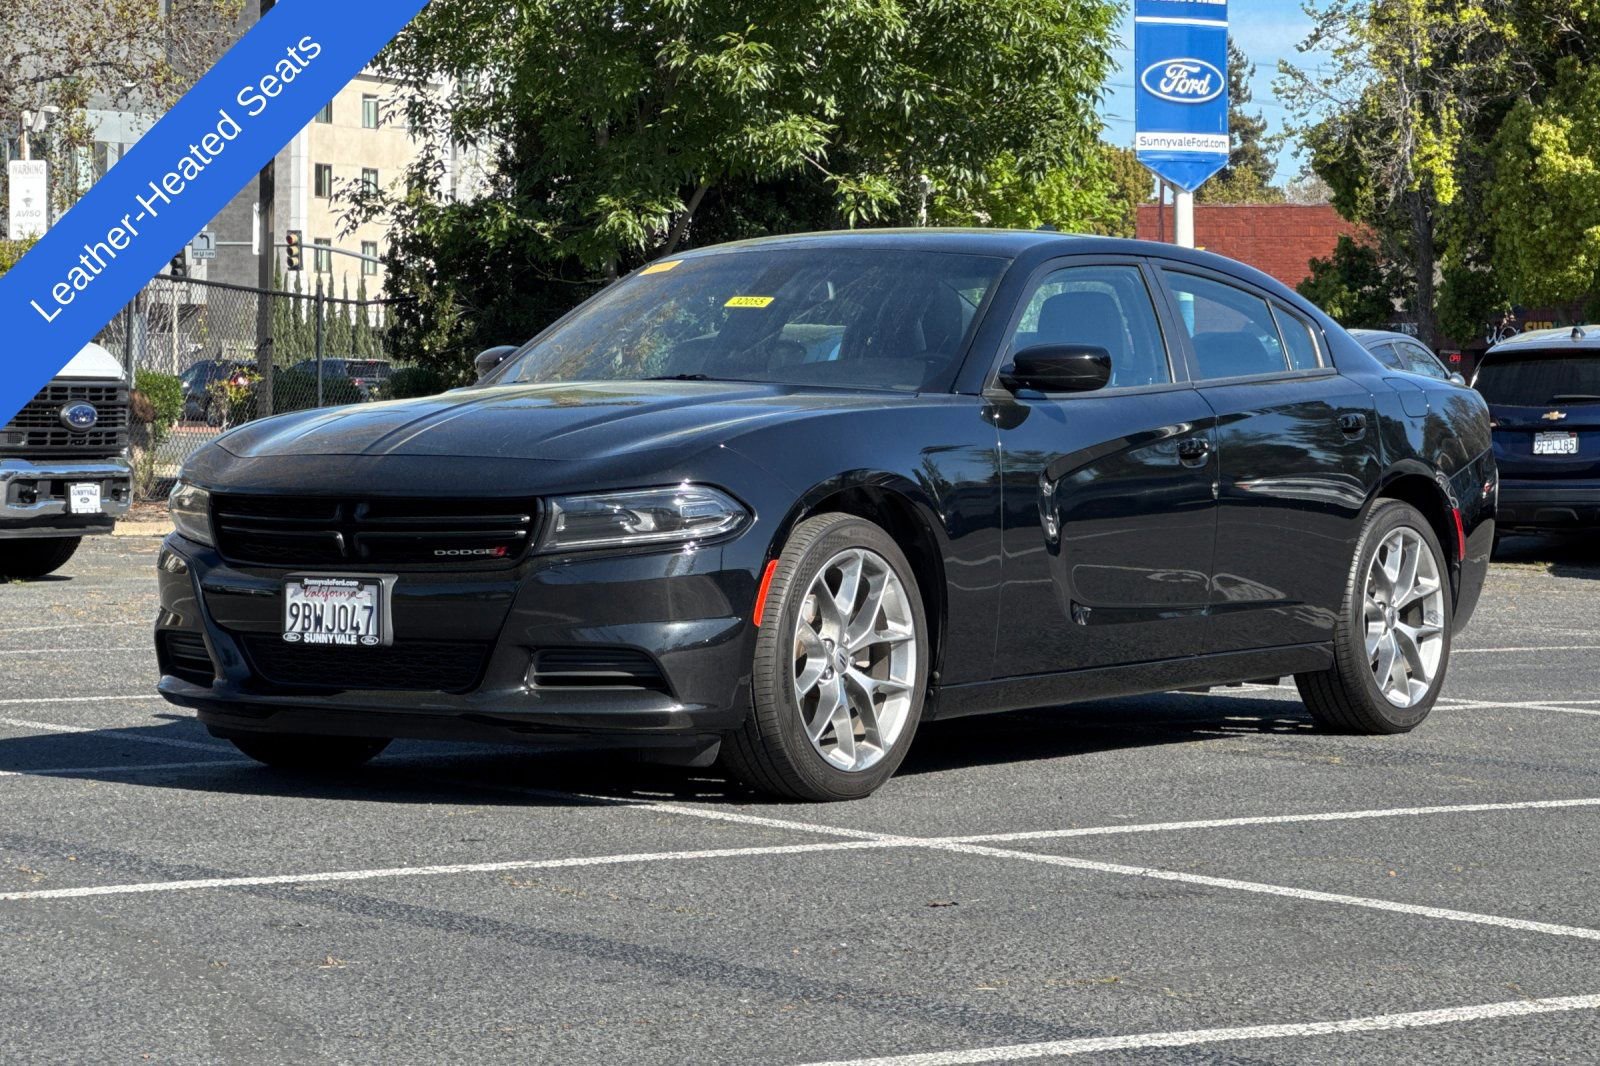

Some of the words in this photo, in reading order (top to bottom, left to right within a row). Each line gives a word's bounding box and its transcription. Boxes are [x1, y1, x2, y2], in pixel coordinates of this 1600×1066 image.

[1159, 63, 1211, 95] Ford
[1139, 136, 1227, 149] SunnyvaleFord.com
[15, 209, 41, 218] AVISO
[434, 548, 497, 556] DODGE
[304, 578, 359, 587] SunnyvaleFord.com
[304, 585, 358, 601] California
[288, 602, 374, 635] 9BWJ047
[303, 632, 358, 645] SUNNYVALE
